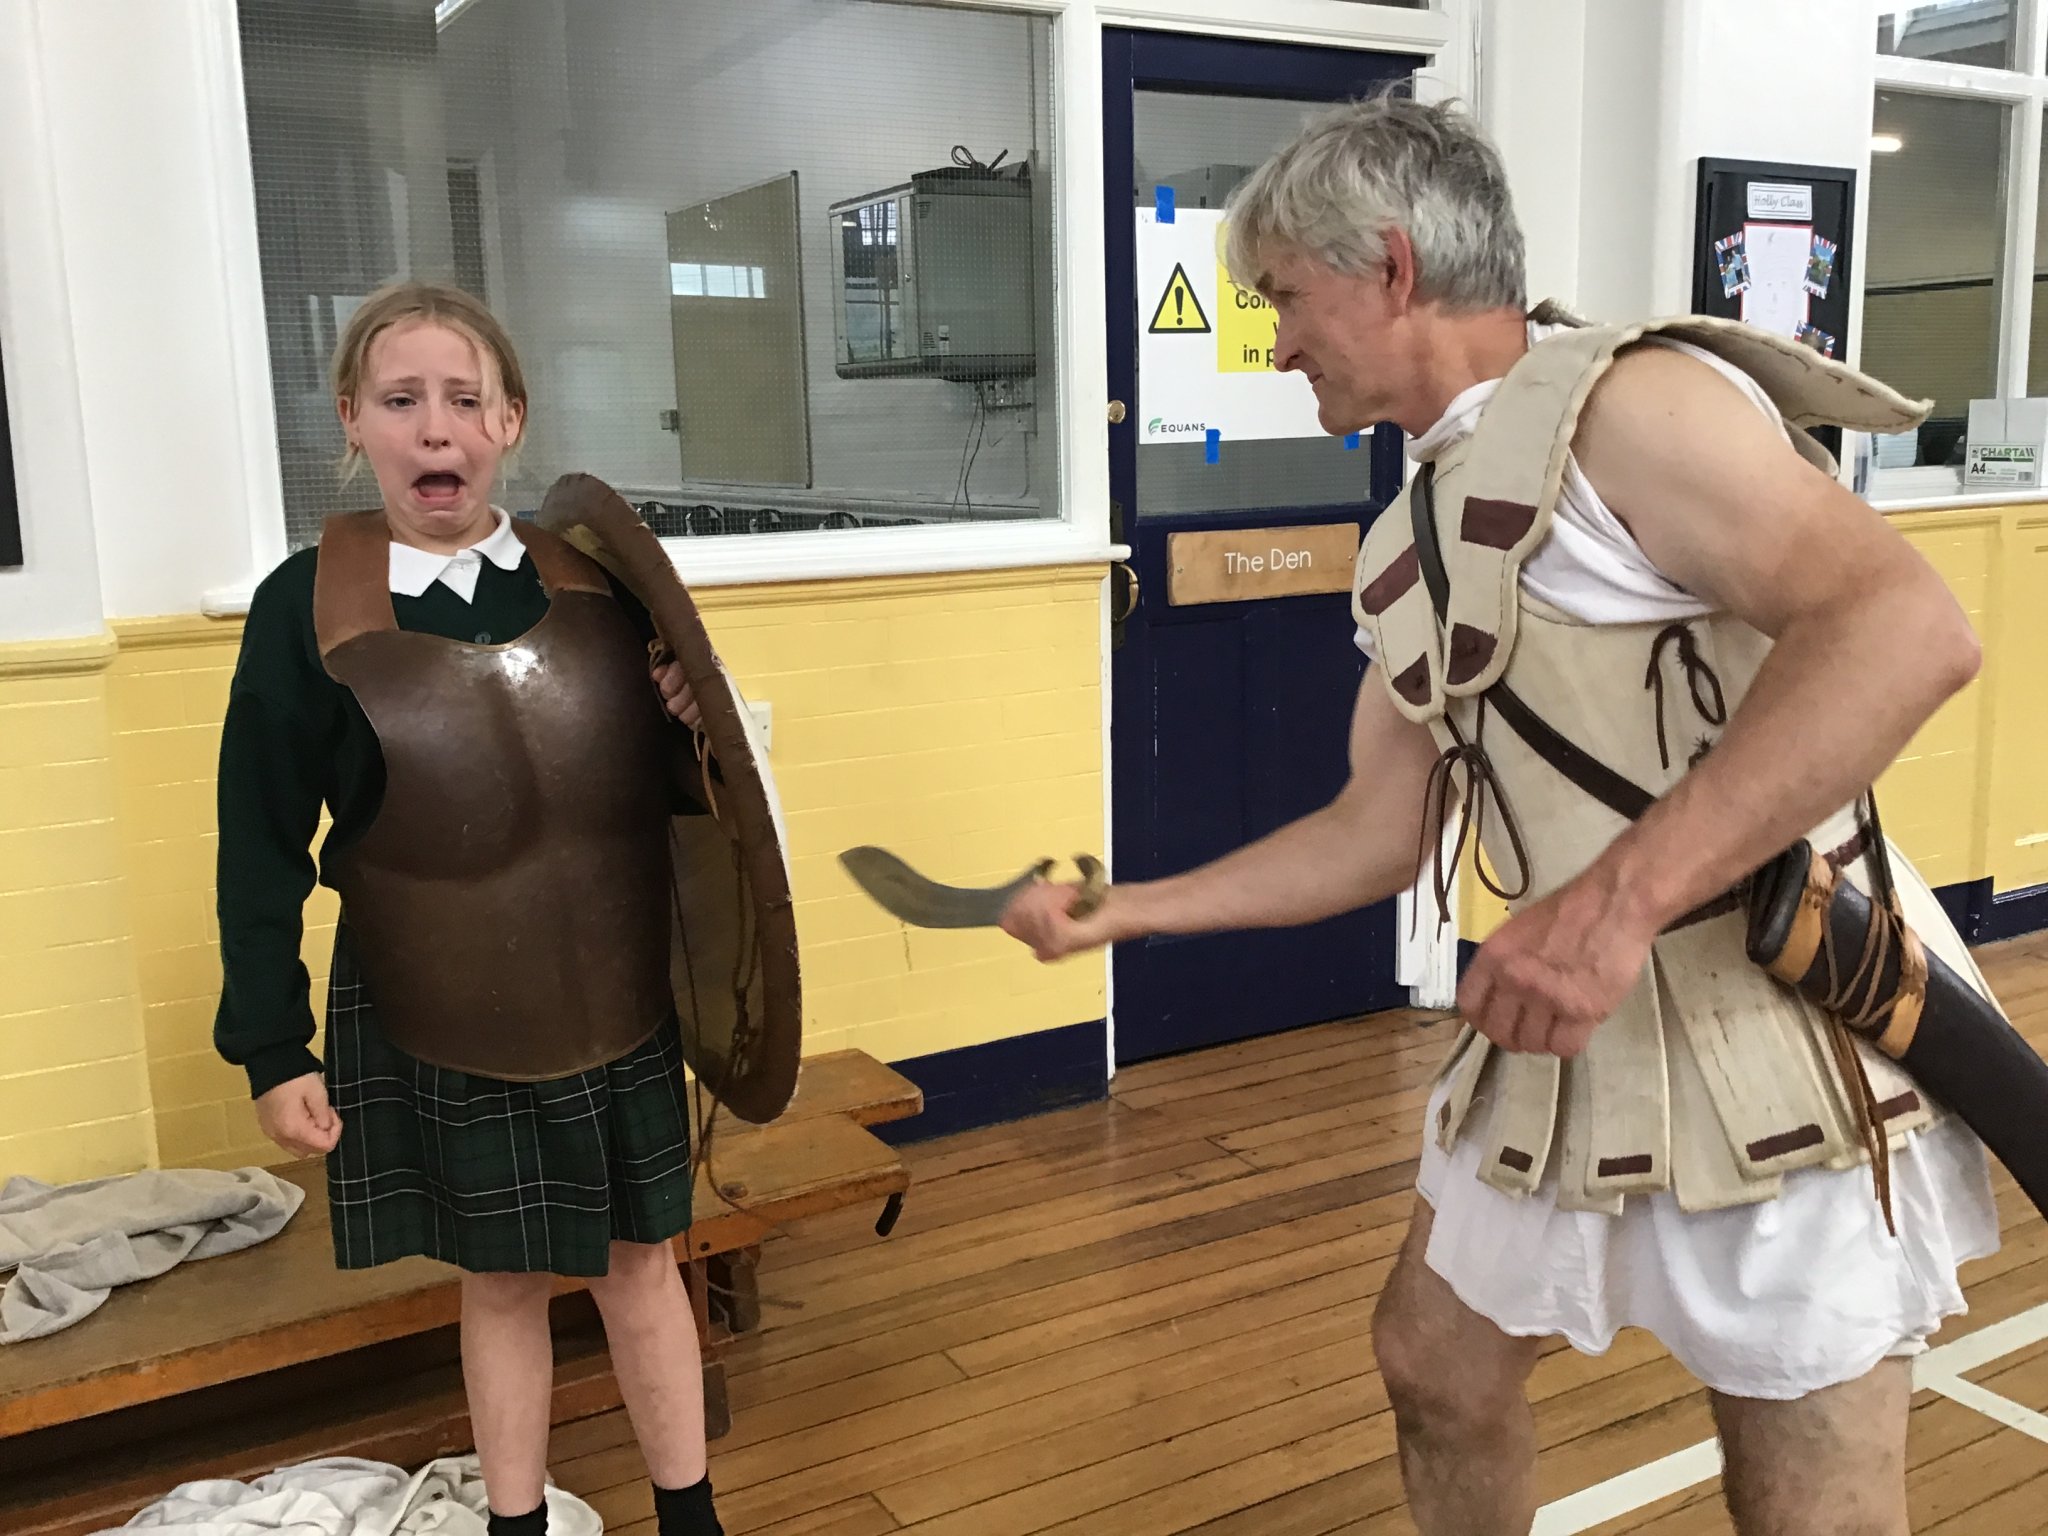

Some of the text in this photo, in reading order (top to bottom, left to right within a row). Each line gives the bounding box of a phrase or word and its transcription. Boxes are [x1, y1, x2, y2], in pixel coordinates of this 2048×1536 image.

[1754, 194, 1804, 210] Holly Class
[1243, 344, 1259, 363] in
[1161, 423, 1206, 433] EQUANS
[1971, 462, 1986, 475] A4
[1224, 548, 1312, 575] The Den
